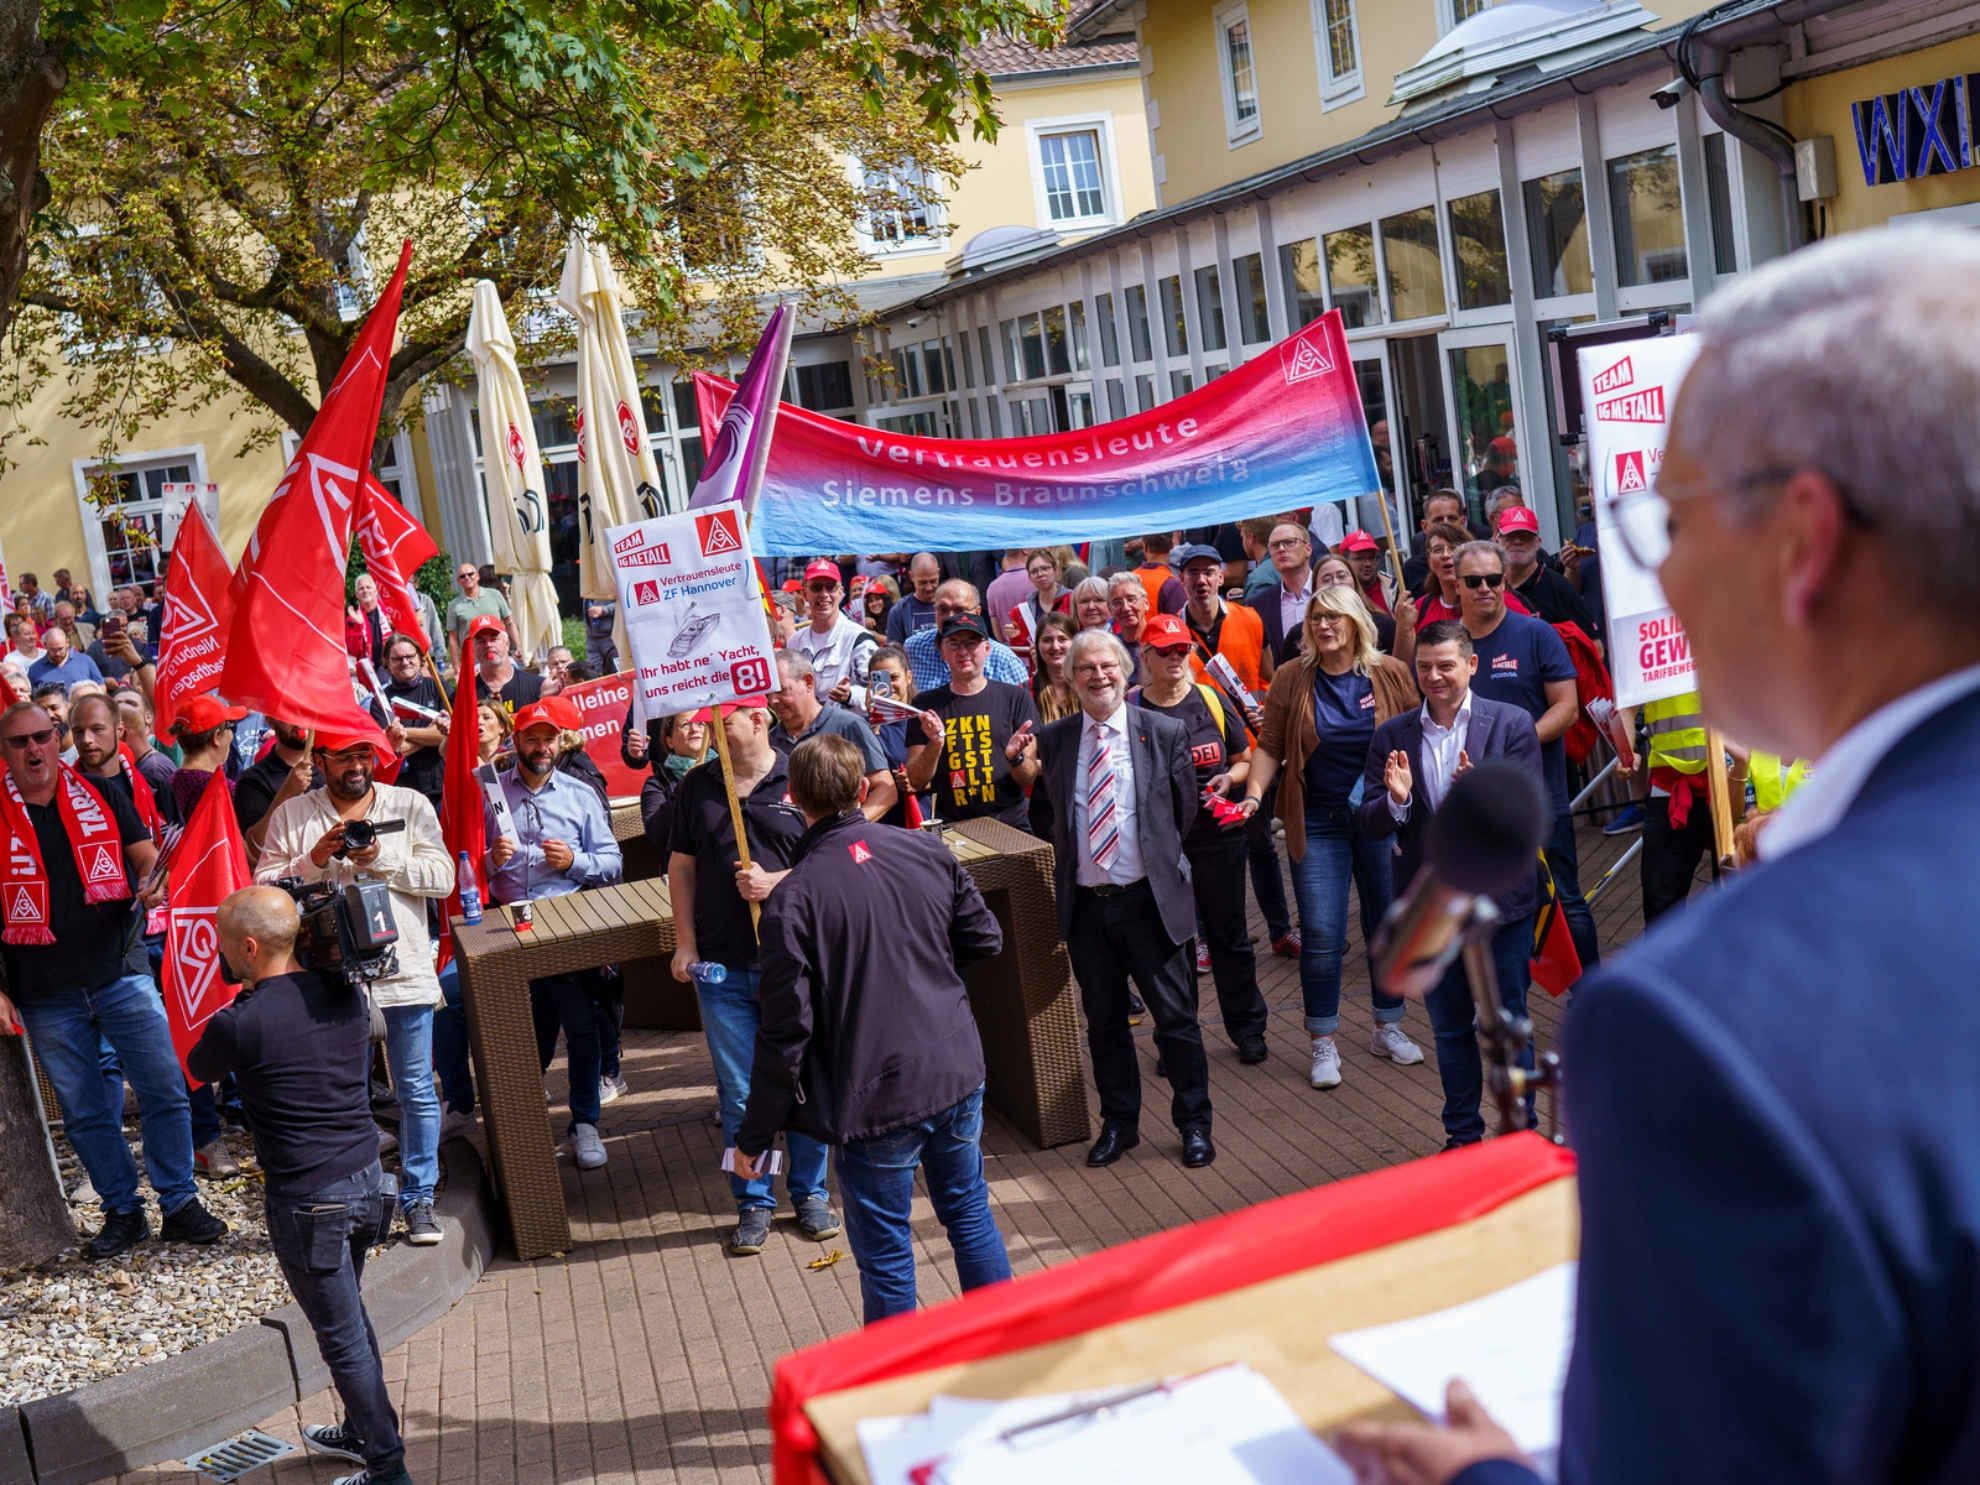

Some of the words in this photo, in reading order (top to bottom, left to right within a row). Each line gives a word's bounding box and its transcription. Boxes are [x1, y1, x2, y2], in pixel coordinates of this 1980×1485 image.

[1850, 74, 1980, 187] WXI
[1593, 358, 1632, 393] TEAM
[857, 417, 1199, 469] Vertrauensleute
[822, 480, 974, 507] Siemens
[994, 455, 1250, 507] Braunschweig
[615, 532, 643, 553] TEAM
[659, 561, 741, 587] Vertrauensleute
[663, 588, 678, 601] ZF
[681, 576, 737, 597] Hannover
[640, 667, 659, 680] Ihr
[661, 660, 691, 675] habt
[718, 644, 760, 662] Yacht,
[1642, 661, 1697, 684] TARIFBEWEG
[645, 684, 669, 699] uns
[672, 675, 708, 692] reicht
[711, 670, 730, 684] die
[735, 661, 767, 692] 8!
[571, 686, 629, 711] lleine
[374, 911, 387, 933] 1
